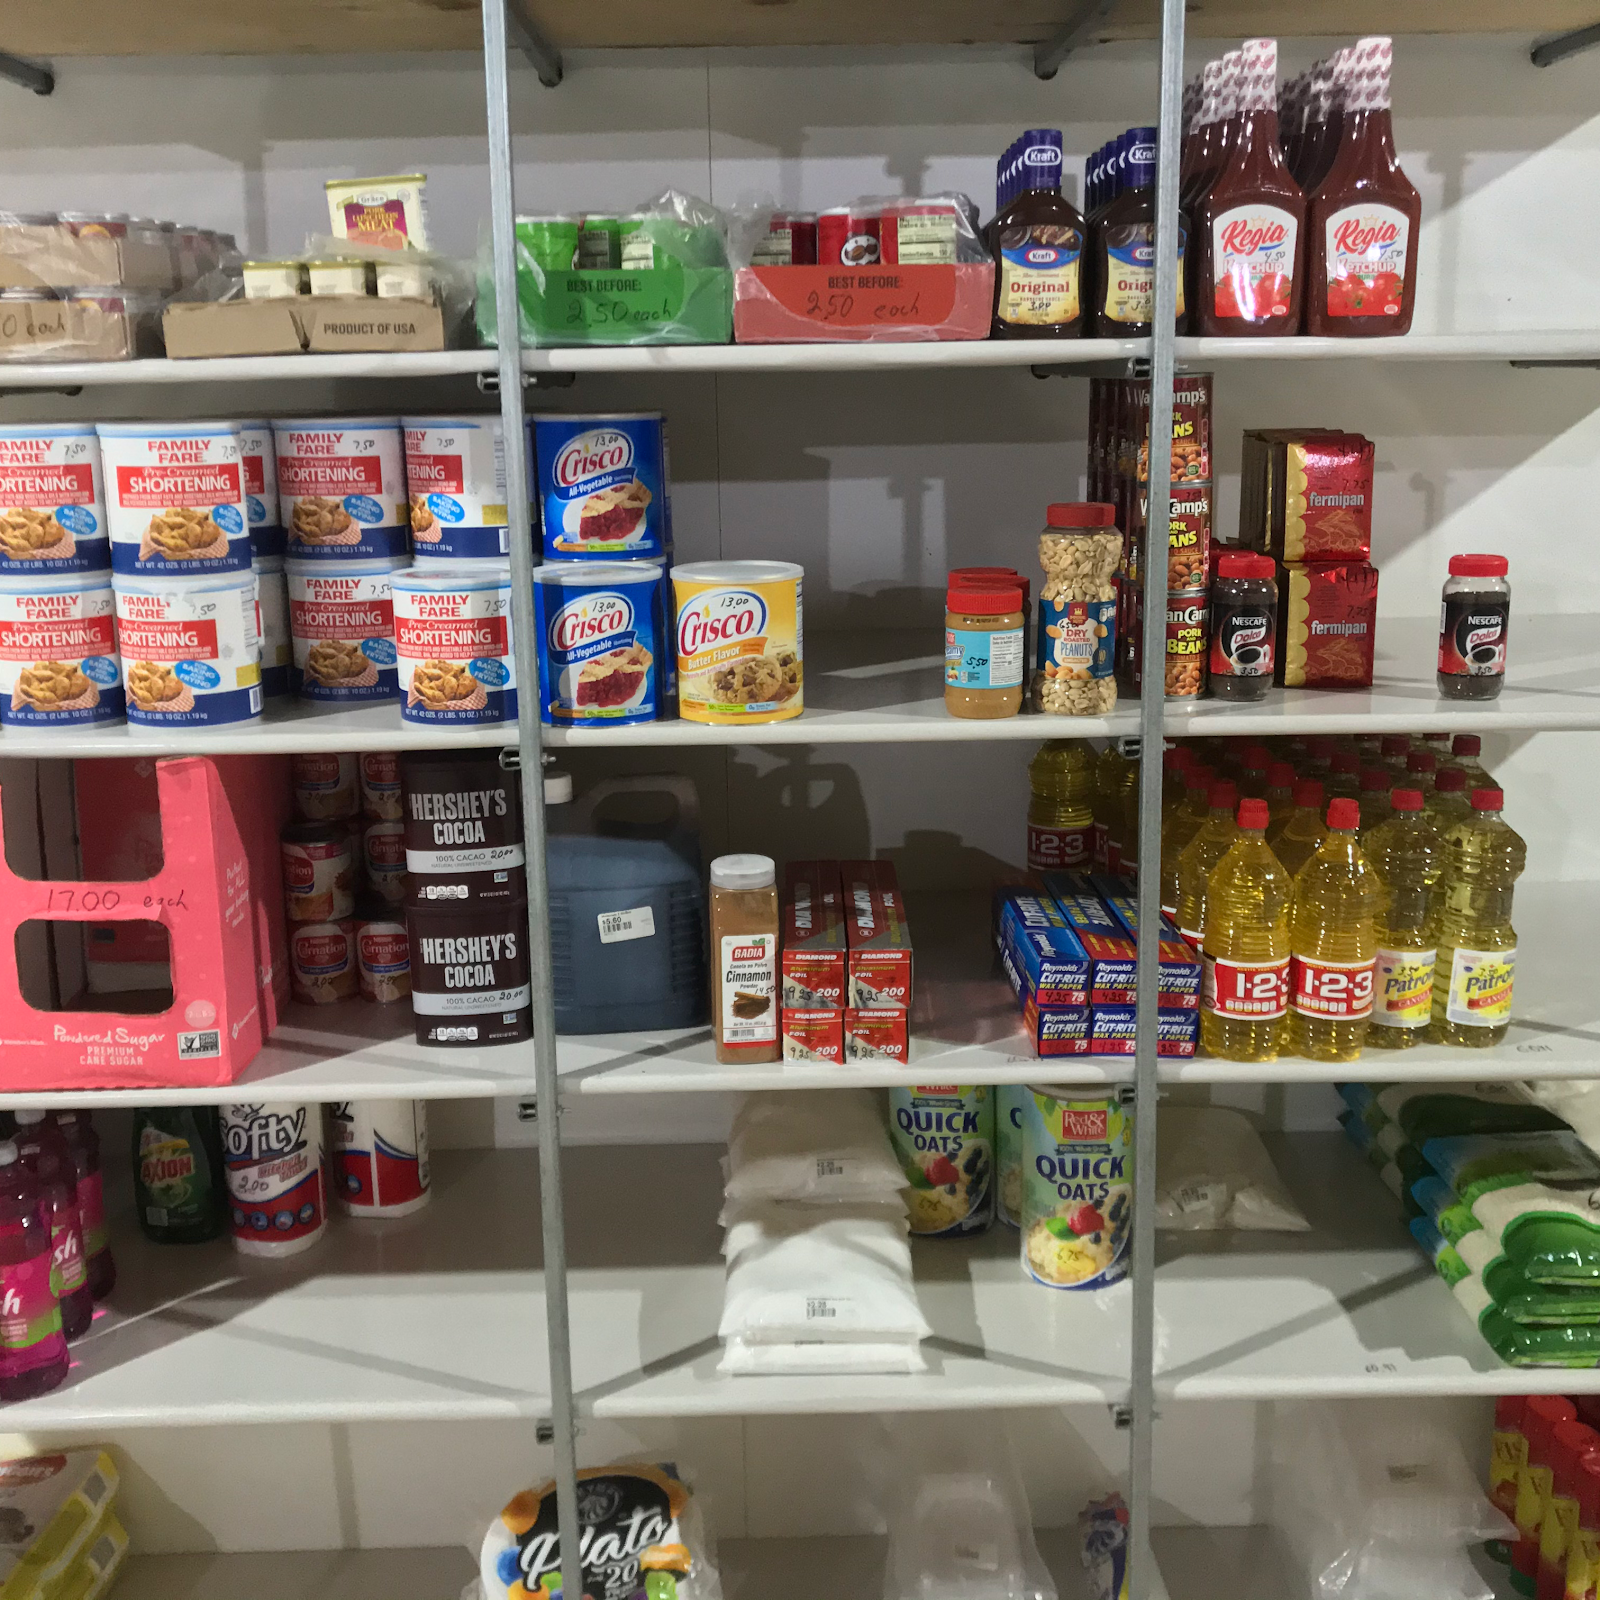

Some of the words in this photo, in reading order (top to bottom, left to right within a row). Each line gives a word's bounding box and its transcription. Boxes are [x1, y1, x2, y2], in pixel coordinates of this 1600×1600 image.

[1030, 151, 1056, 161] Kraft
[358, 219, 394, 232] MEAT
[1221, 218, 1289, 256] Regia
[1333, 219, 1401, 256] Regia
[1032, 252, 1052, 260] Kraft
[1265, 251, 1286, 263] 4.50
[567, 279, 592, 292] BEST
[596, 279, 642, 292] BEFORE:
[828, 276, 854, 289] BEST
[1011, 281, 1070, 295] Original
[1118, 279, 1152, 293] Origi
[807, 290, 854, 320] 2.50
[874, 292, 919, 319] each
[566, 300, 629, 328] 2.50
[634, 298, 671, 320] each
[323, 322, 374, 336] PRODUCT
[377, 322, 391, 335] OF
[394, 322, 416, 335] USA
[289, 433, 343, 444] FAMILY
[595, 435, 618, 447] 13.00
[148, 440, 211, 452] FAMILY
[296, 444, 335, 455] FARE
[159, 452, 204, 464] FARE
[142, 465, 219, 477] Pre-Creamed
[560, 446, 623, 486] Crisco
[281, 466, 365, 482] SHORTENING
[130, 474, 230, 493] SHORTENING
[569, 475, 613, 498] All-Vegetable
[1309, 492, 1364, 507] fermipan
[1169, 531, 1197, 548] ANS
[306, 579, 362, 589] FAMILY
[16, 595, 79, 608] FAMILY
[314, 591, 354, 600] FARE
[410, 595, 469, 605] FAMILY
[484, 599, 506, 615] 7.50
[593, 601, 616, 613] 13.00
[721, 596, 749, 609] 13.00
[26, 608, 71, 619] FARE
[129, 608, 165, 619] FARE
[296, 611, 382, 626] SHORTENING
[419, 607, 461, 617] FARE
[12, 620, 88, 632] Pre-Creamed
[122, 620, 183, 631] Pre-Creamed
[407, 620, 478, 629] Pre-Creamed
[557, 610, 623, 650] Crisco
[1311, 620, 1367, 637] fermipan
[0, 628, 101, 647] SHORTENING
[400, 629, 491, 645] SHORTENING
[680, 609, 753, 657] Crisco
[1066, 629, 1088, 637] DRY
[1177, 628, 1202, 639] PORK
[1234, 630, 1262, 644] Dolca
[566, 639, 612, 662] All-Vegetable
[1061, 642, 1093, 657] PEANUTS
[1167, 638, 1207, 655] BEANS
[688, 655, 711, 670] Butter
[713, 646, 740, 661] Flavor
[966, 657, 988, 669] 5.50
[182, 663, 215, 679] BAKING
[477, 661, 506, 676] BAKING
[180, 673, 211, 689] FRYING
[474, 672, 502, 685] FRYING
[411, 789, 507, 820] HERSHEY'S
[433, 821, 485, 845] COCOA
[456, 853, 486, 862] CACAO
[46, 889, 120, 913] 17.00
[144, 890, 188, 910] each
[297, 941, 345, 958] Carnation
[362, 939, 409, 956] Carnation
[422, 933, 517, 964] HERSHEY'S
[734, 948, 763, 958] BADIA
[1041, 963, 1078, 972] Reynolds
[1096, 963, 1133, 972] Reynolds
[445, 964, 495, 988] COCOA
[726, 970, 771, 983] Cinnamon
[1040, 972, 1087, 984] CUT-RITE
[1384, 970, 1434, 995] Patro
[1465, 966, 1515, 992] Patro
[816, 988, 840, 997] 200
[881, 987, 905, 996] 200
[1072, 992, 1085, 1002] 75
[466, 995, 495, 1004] CACAO
[1183, 995, 1197, 1006] 75
[1043, 1013, 1079, 1022] Reynolds
[1094, 1012, 1131, 1021] Reynolds
[1042, 1023, 1089, 1034] CUT-RITE
[54, 1024, 111, 1044] Powdered
[115, 1027, 165, 1051] Sugar
[87, 1046, 134, 1056] PREMIUM
[815, 1046, 838, 1055] 200
[879, 1045, 902, 1054] 200
[1075, 1040, 1087, 1050] 75
[1179, 1042, 1193, 1052] 75
[79, 1056, 106, 1066] CANE
[110, 1056, 144, 1066] SUGAR
[897, 1108, 980, 1136] QUICK
[1065, 1112, 1088, 1127] Red
[1088, 1113, 1105, 1129] &
[1070, 1124, 1105, 1136] White
[914, 1135, 964, 1153] OATS
[141, 1155, 192, 1183] AXION
[1036, 1155, 1126, 1184] QUICK
[1057, 1182, 1109, 1201] OATS
[605, 1562, 638, 1587] 20
